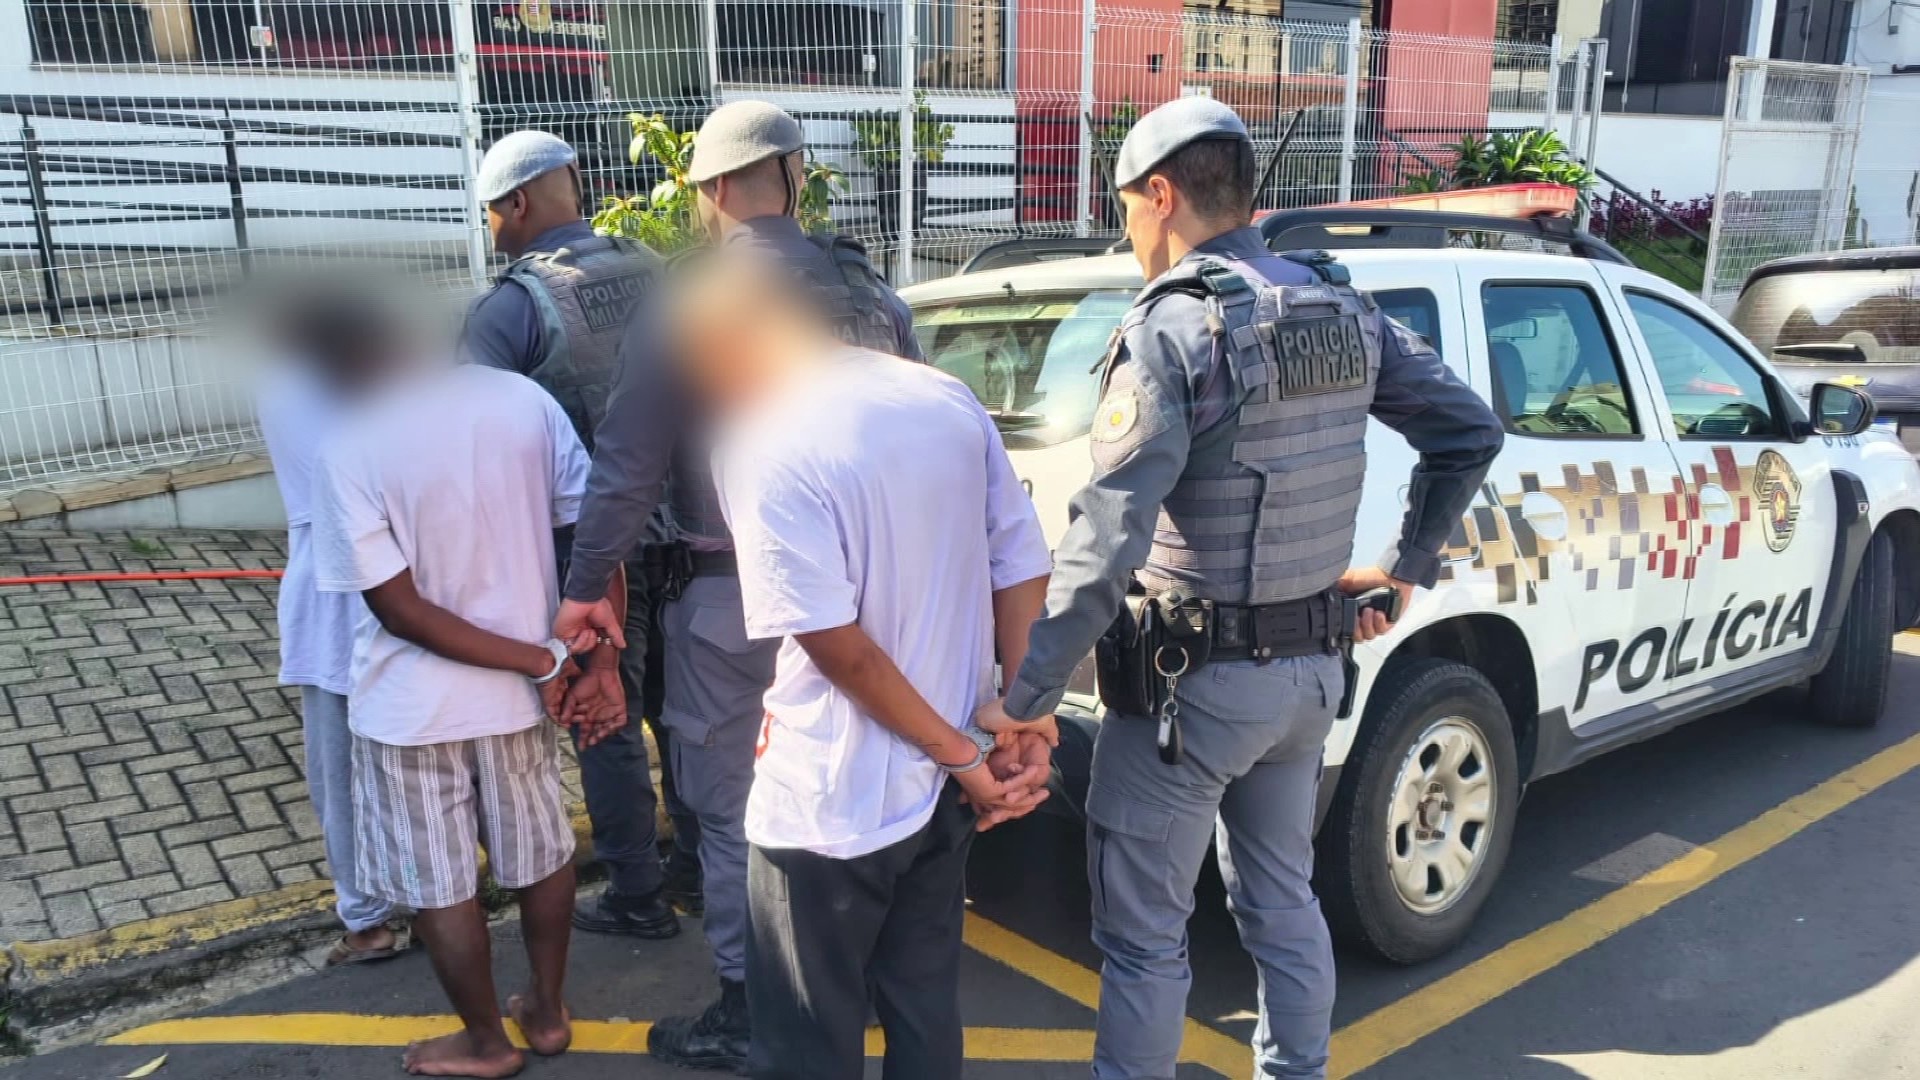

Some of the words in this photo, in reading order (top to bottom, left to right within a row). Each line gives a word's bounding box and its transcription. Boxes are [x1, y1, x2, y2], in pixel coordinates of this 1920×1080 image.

[581, 276, 654, 307] POLÍCIA
[1281, 322, 1361, 358] POLÍCIA
[1286, 353, 1362, 390] MILITAR
[1573, 587, 1812, 714] POLÍCIA
